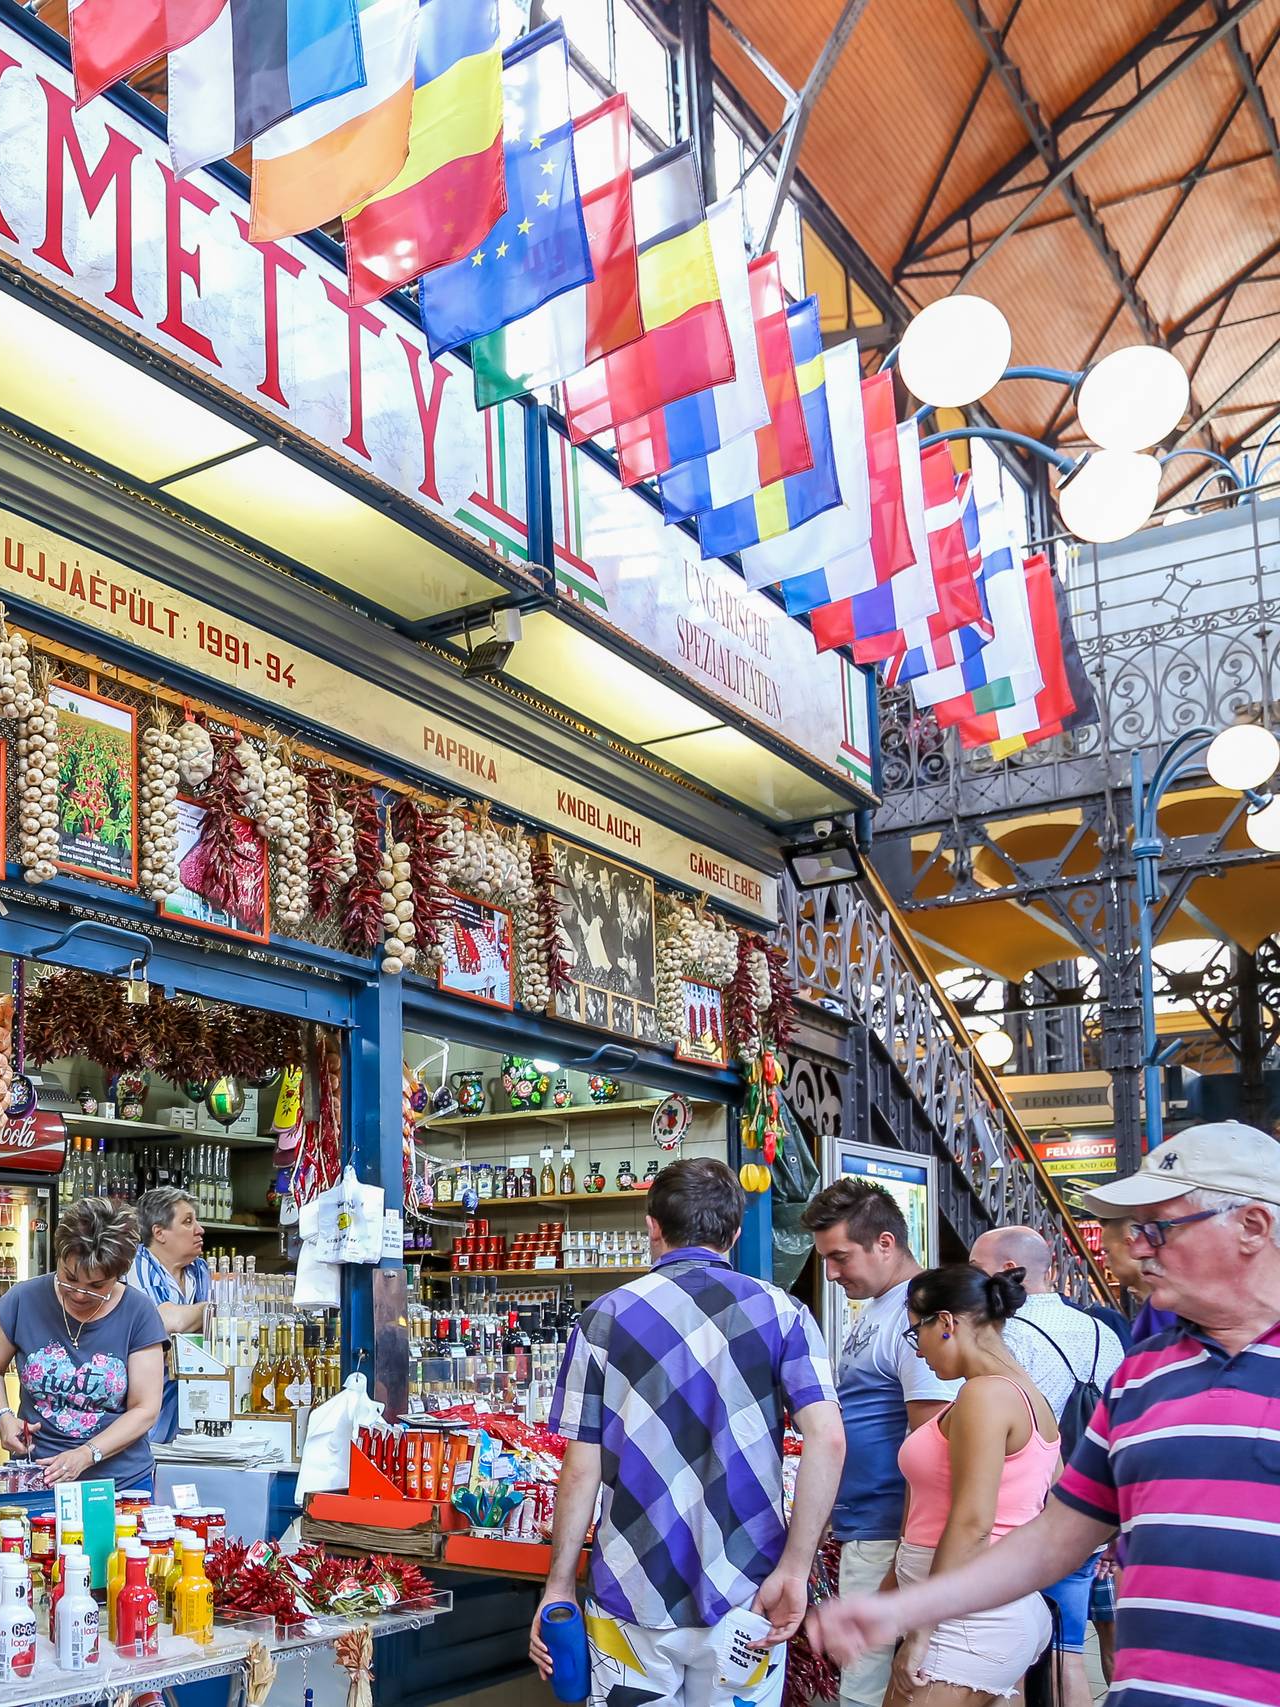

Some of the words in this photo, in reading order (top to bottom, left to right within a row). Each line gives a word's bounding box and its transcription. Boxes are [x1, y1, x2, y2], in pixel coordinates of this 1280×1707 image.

[682, 558, 772, 661] UNGARISCHE
[196, 620, 297, 689] 1991-94
[675, 613, 783, 722] SPEZIALITÄTEN
[422, 725, 498, 784] PAPRIKA
[556, 788, 642, 848] KNOBLAUCH
[689, 852, 762, 904] GÄNSELEBER
[1045, 1143, 1116, 1158] FELVÁGOTT
[1099, 1160, 1117, 1169] GO
[728, 1654, 749, 1669] HELL
[734, 1629, 752, 1642] ALL
